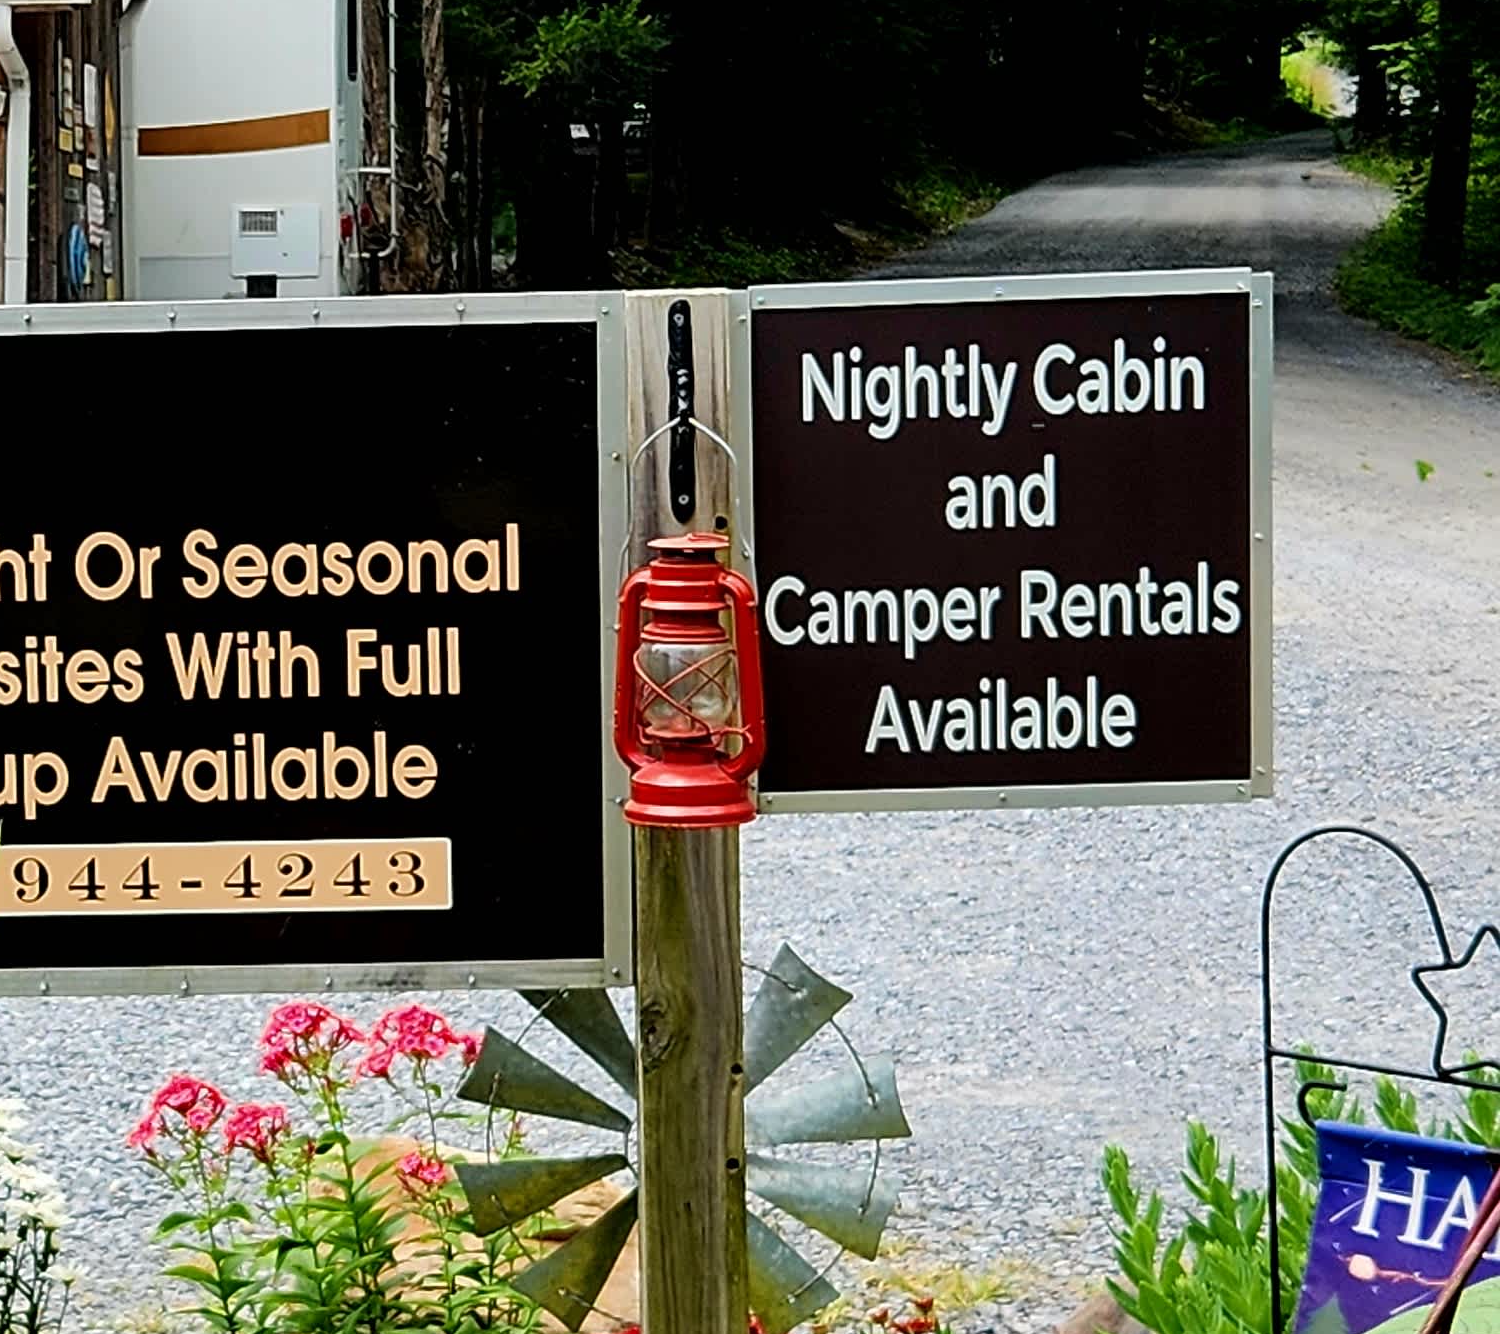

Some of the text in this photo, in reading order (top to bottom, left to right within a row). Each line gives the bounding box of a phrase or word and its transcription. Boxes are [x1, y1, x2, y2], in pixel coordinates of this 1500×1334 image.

[802, 336, 1205, 439] Nightly Cabin
[945, 454, 1056, 530] and
[75, 531, 161, 601] Or
[182, 525, 521, 598] Seasonal
[765, 562, 1241, 659] Camper Rentals
[166, 630, 321, 700] With
[346, 627, 462, 696] Full
[865, 676, 1137, 753] Available
[92, 731, 439, 803] Available
[1351, 1158, 1500, 1261] HA
